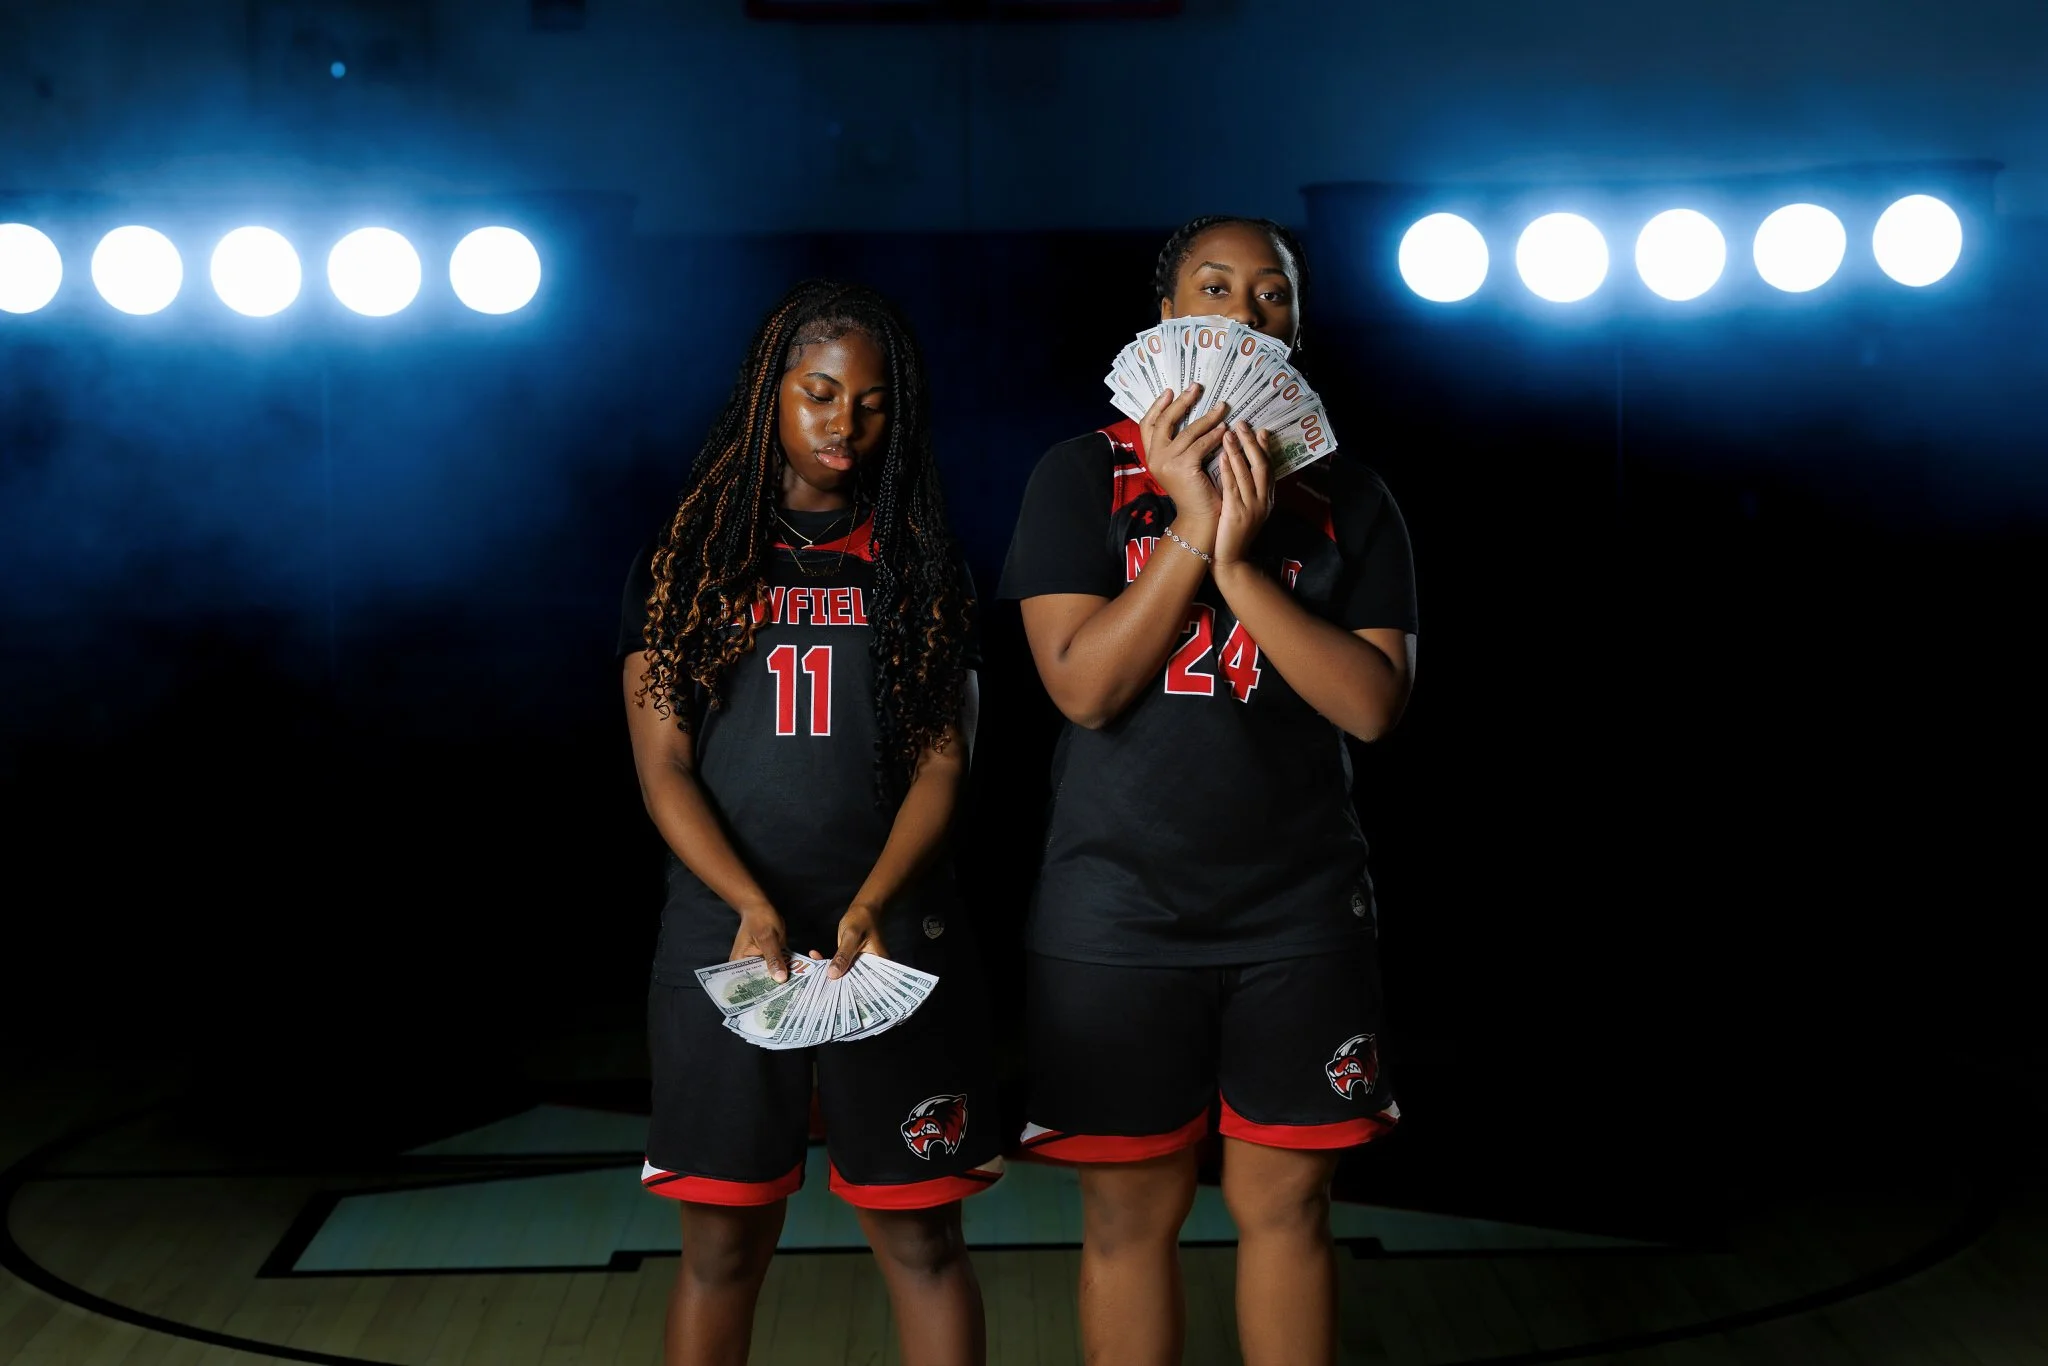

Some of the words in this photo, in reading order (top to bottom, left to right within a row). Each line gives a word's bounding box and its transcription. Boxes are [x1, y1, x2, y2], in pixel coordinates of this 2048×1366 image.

[1299, 414, 1326, 452] 100
[731, 586, 870, 628] WFIEL
[1164, 602, 1262, 704] 24
[766, 644, 833, 737] 11
